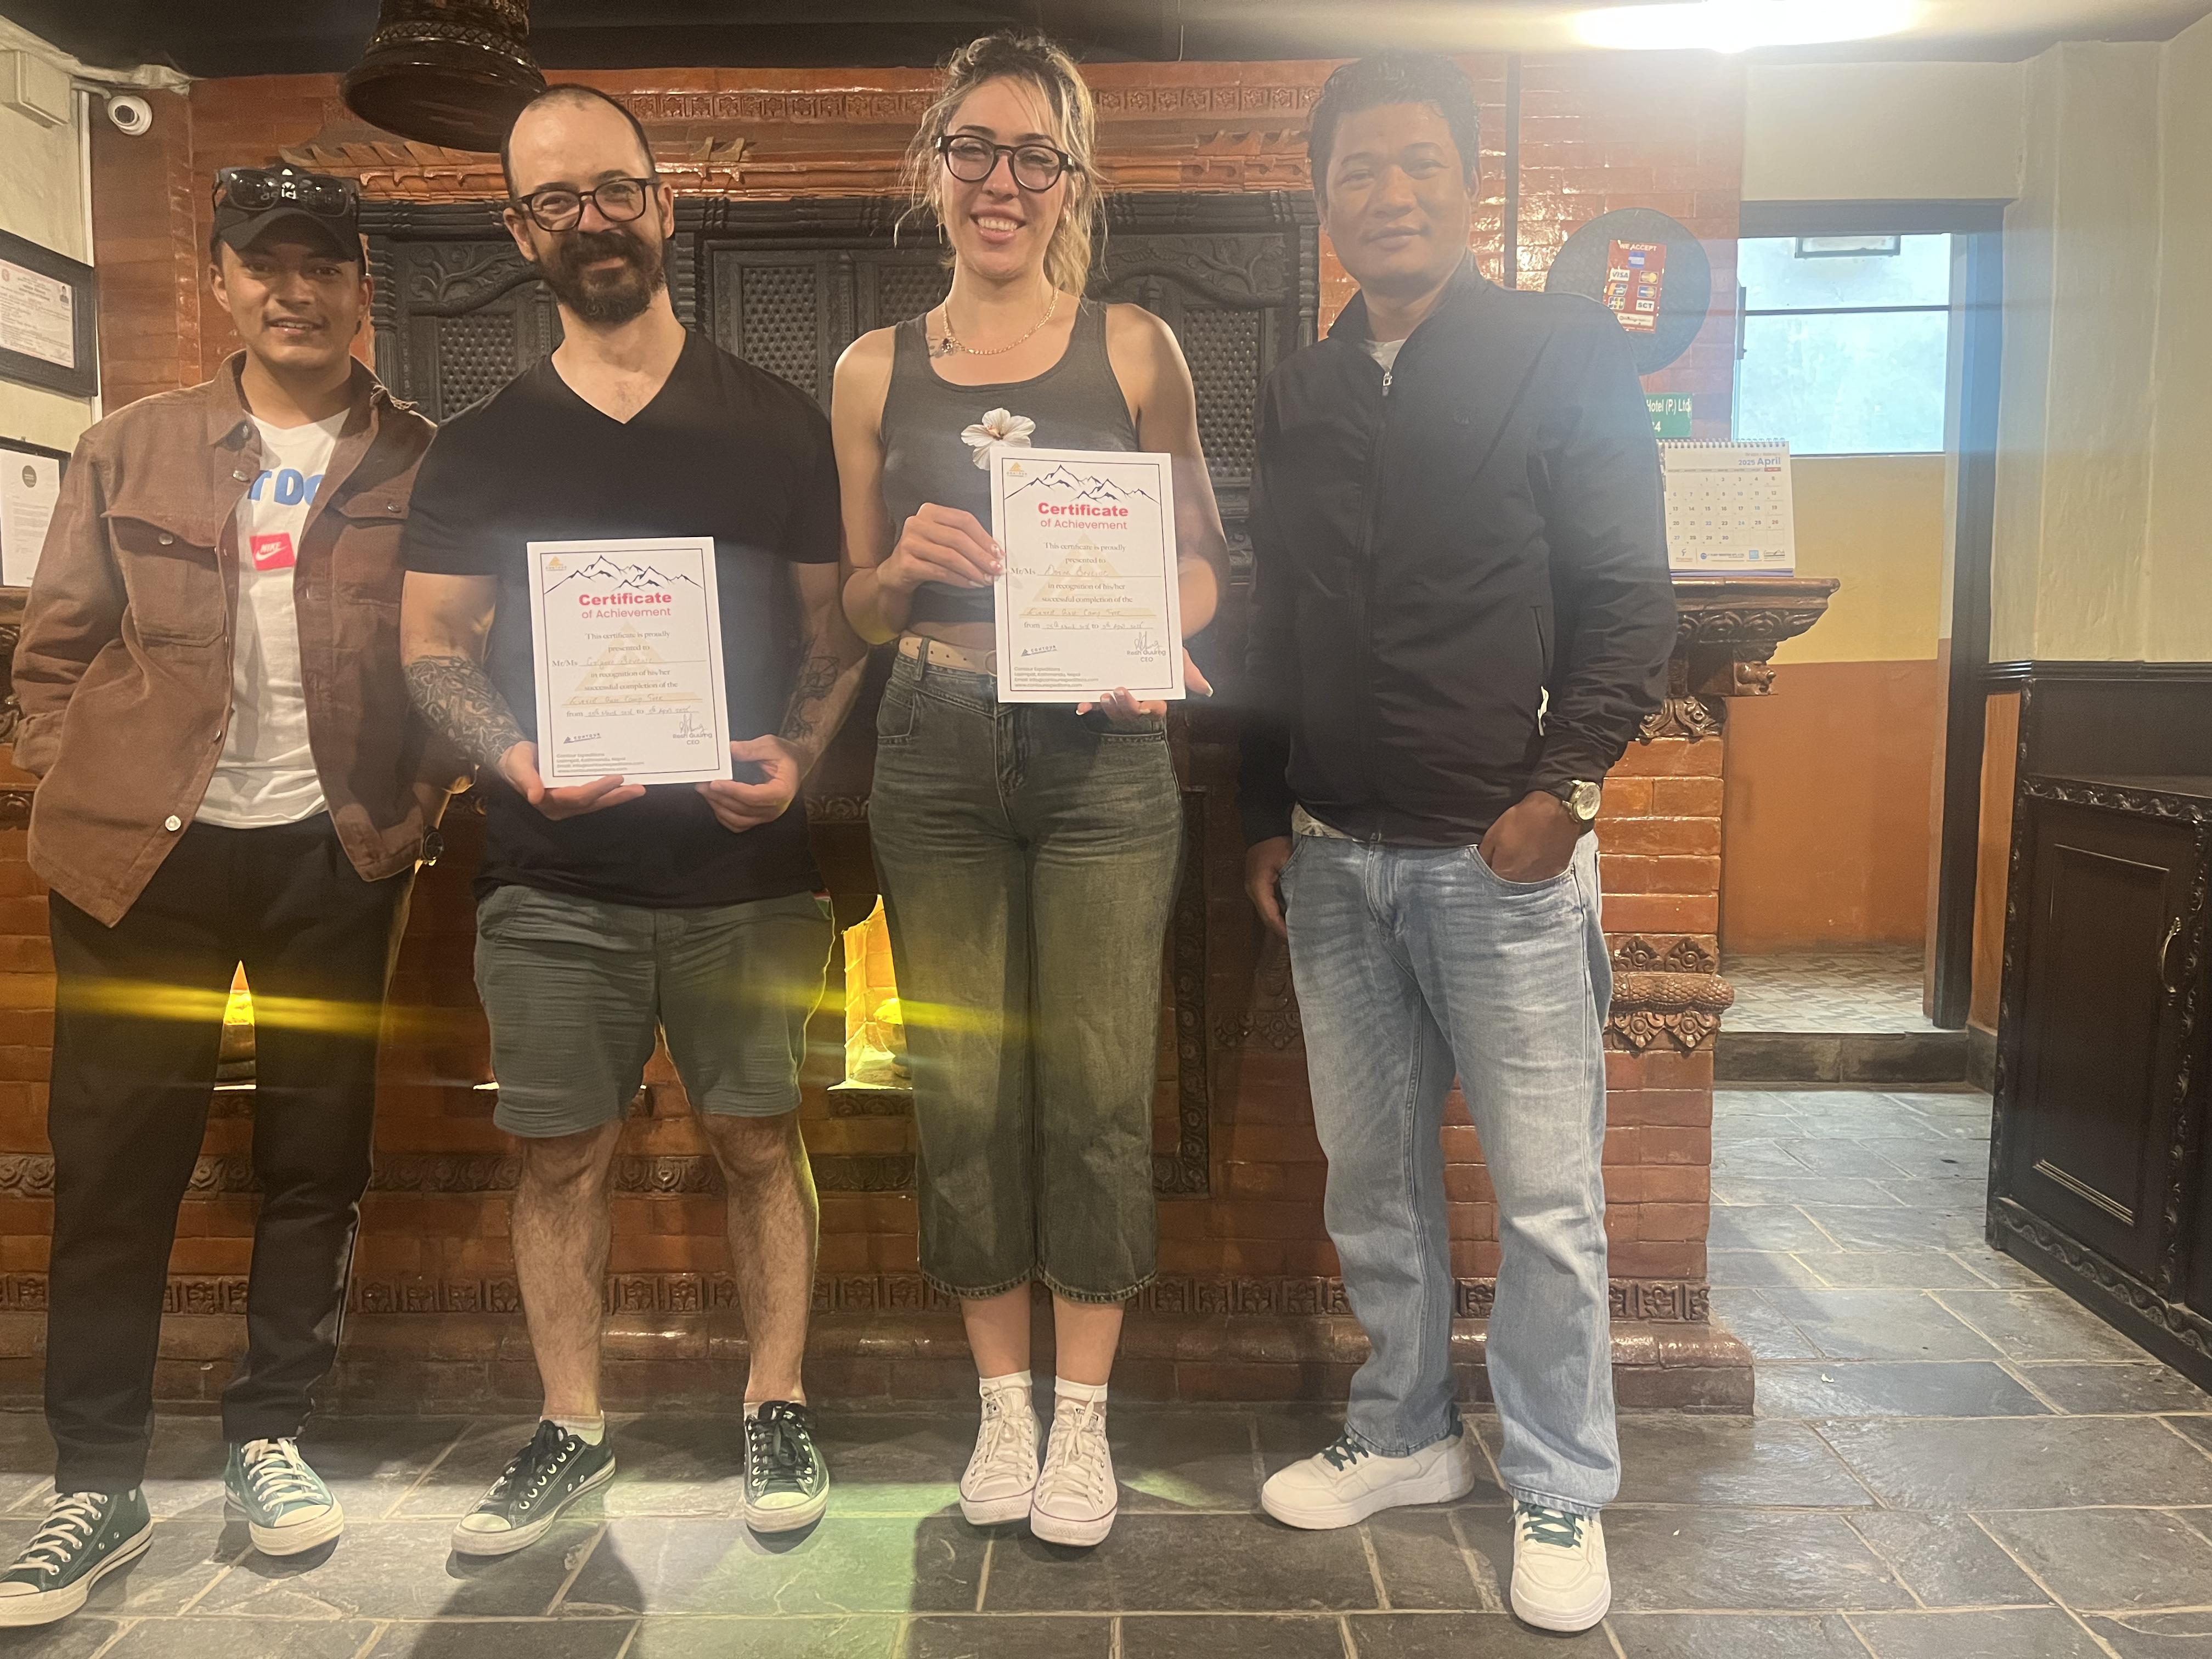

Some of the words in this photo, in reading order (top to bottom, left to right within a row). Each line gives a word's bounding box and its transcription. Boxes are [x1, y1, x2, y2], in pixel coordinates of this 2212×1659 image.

[1646, 399, 1664, 412] Hotel
[1652, 421, 1661, 432] 4
[1757, 456, 1781, 467] April
[1038, 503, 1128, 517] Certificate
[1040, 518, 1051, 527] of
[1054, 519, 1127, 529] Achievement
[260, 541, 281, 553] NIKE
[579, 592, 672, 606] Certificate
[582, 610, 592, 619] of
[596, 608, 671, 618] Achievement
[644, 631, 670, 639] proudly
[608, 645, 641, 653] presented
